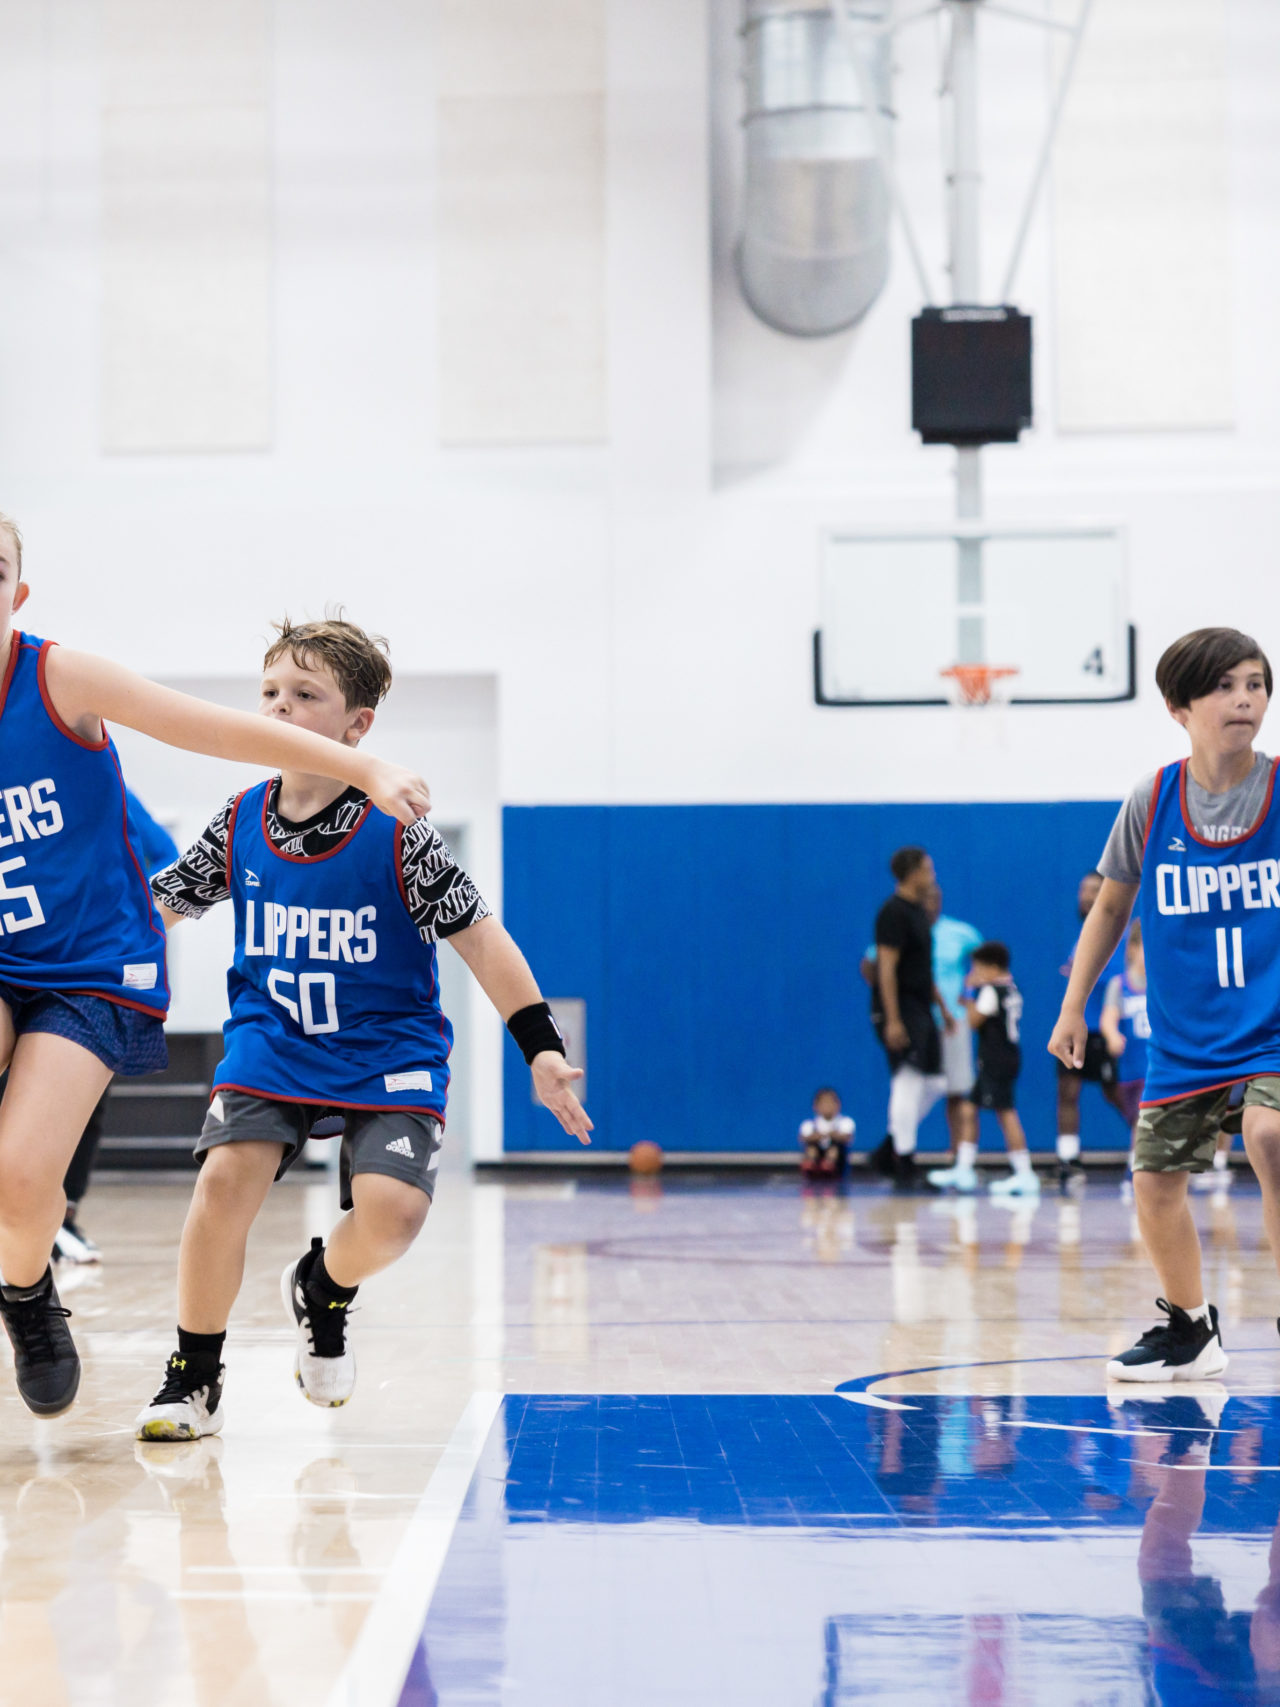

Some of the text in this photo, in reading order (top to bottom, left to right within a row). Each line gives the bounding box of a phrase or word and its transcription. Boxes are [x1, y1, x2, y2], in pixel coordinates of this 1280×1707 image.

[1156, 859, 1280, 915] CLIPPER
[1216, 927, 1245, 988] 11
[267, 968, 339, 1035] 50
